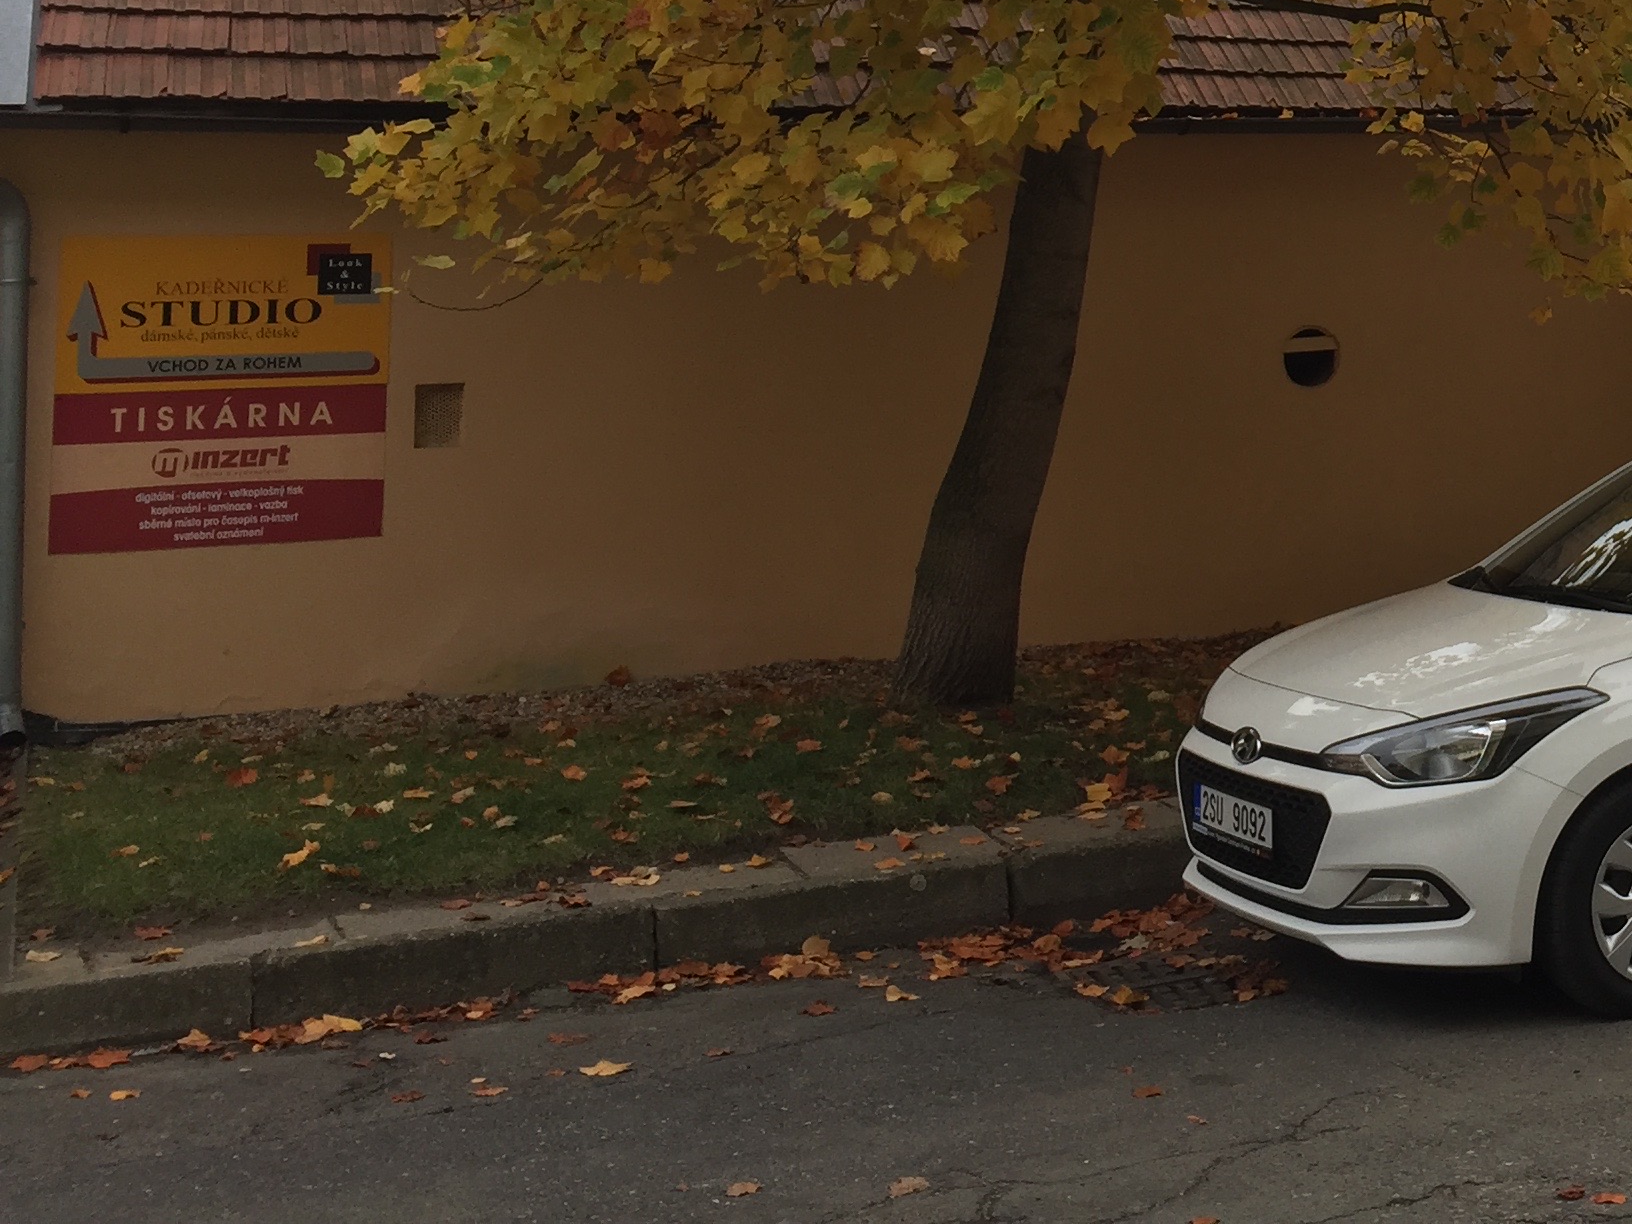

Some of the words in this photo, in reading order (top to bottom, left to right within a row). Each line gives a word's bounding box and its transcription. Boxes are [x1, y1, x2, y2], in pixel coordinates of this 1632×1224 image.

[328, 258, 363, 268] Look
[339, 269, 349, 279] &
[155, 277, 289, 296] KADEŘNICKÉ
[326, 281, 363, 292] Style
[120, 298, 323, 328] STUDIO
[140, 328, 199, 343] dámské,
[201, 327, 253, 344] pánské,
[255, 325, 301, 340] dětské
[148, 358, 209, 374] VCHOD
[215, 358, 237, 371] ZA
[243, 356, 302, 371] ROHEM
[110, 397, 333, 433] TISKÁRNA
[286, 484, 305, 496] tisk
[207, 501, 253, 514] laminace
[259, 499, 288, 512] vazba
[138, 516, 174, 530] sběrné
[174, 515, 202, 529] místo
[203, 516, 220, 528] pro
[221, 513, 258, 528] časopis
[259, 511, 299, 524] m-inzert
[173, 528, 216, 542] svatební
[216, 526, 265, 541] oznámení
[1202, 790, 1224, 826] 2SU
[1232, 802, 1267, 842] 9092
